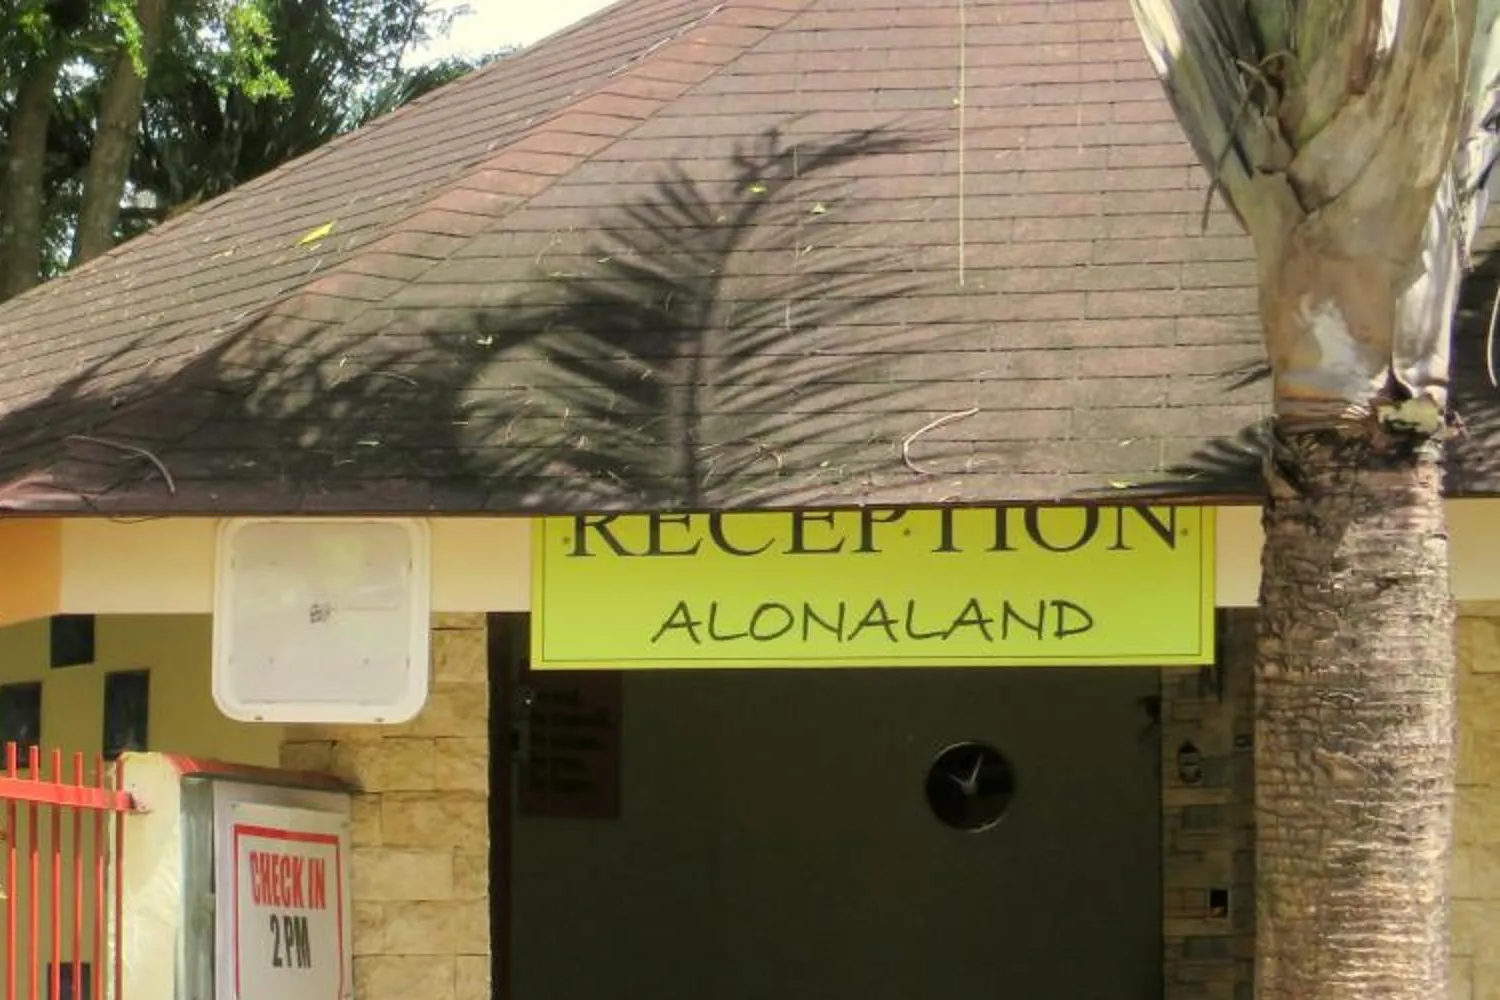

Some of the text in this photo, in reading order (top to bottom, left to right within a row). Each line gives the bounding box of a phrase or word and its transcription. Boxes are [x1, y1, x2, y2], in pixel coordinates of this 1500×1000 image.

[565, 504, 1179, 557] RECEPTION
[651, 598, 1094, 644] ALONALAND
[249, 850, 326, 911] CHECK IN
[269, 913, 312, 969] 2 PM
